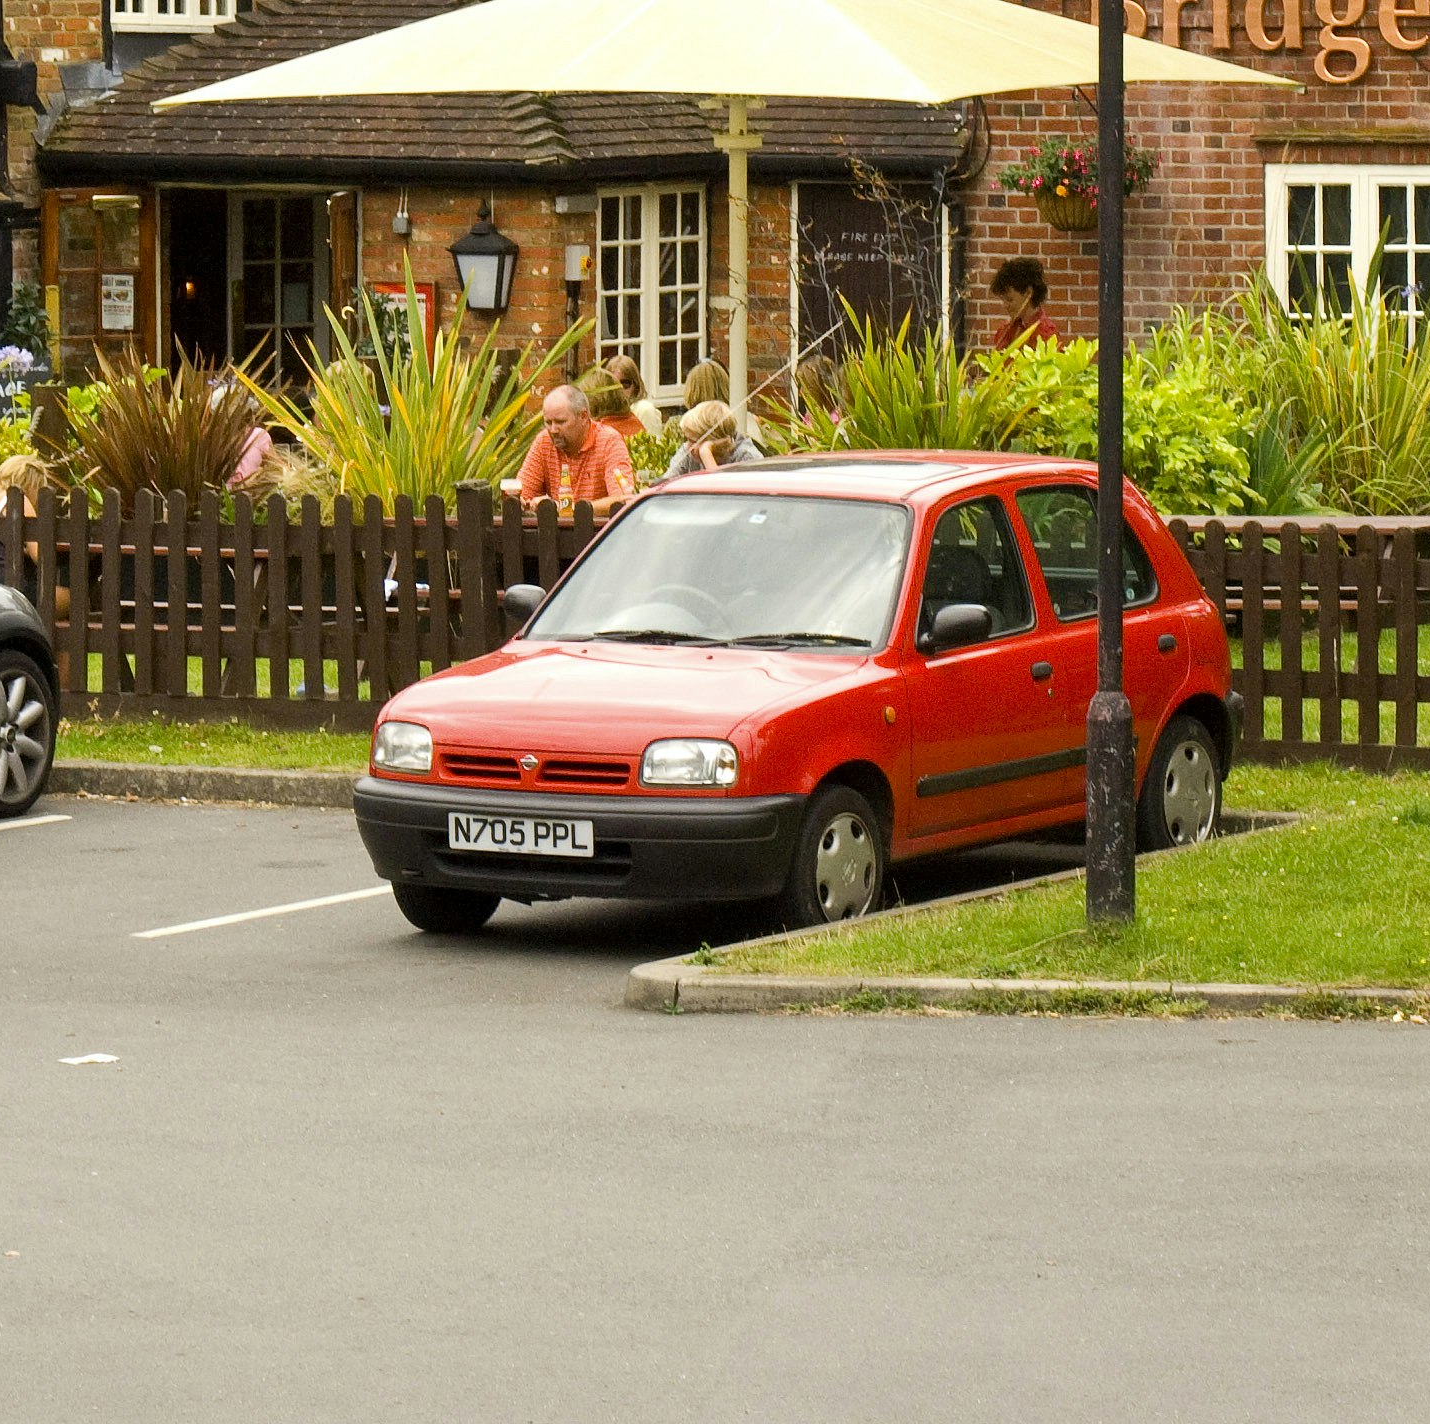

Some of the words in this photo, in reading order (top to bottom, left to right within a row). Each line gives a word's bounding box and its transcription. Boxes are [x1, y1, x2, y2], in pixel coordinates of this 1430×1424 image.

[840, 232, 869, 244] FIRE
[454, 816, 526, 846] N705
[533, 821, 589, 851] PPL
